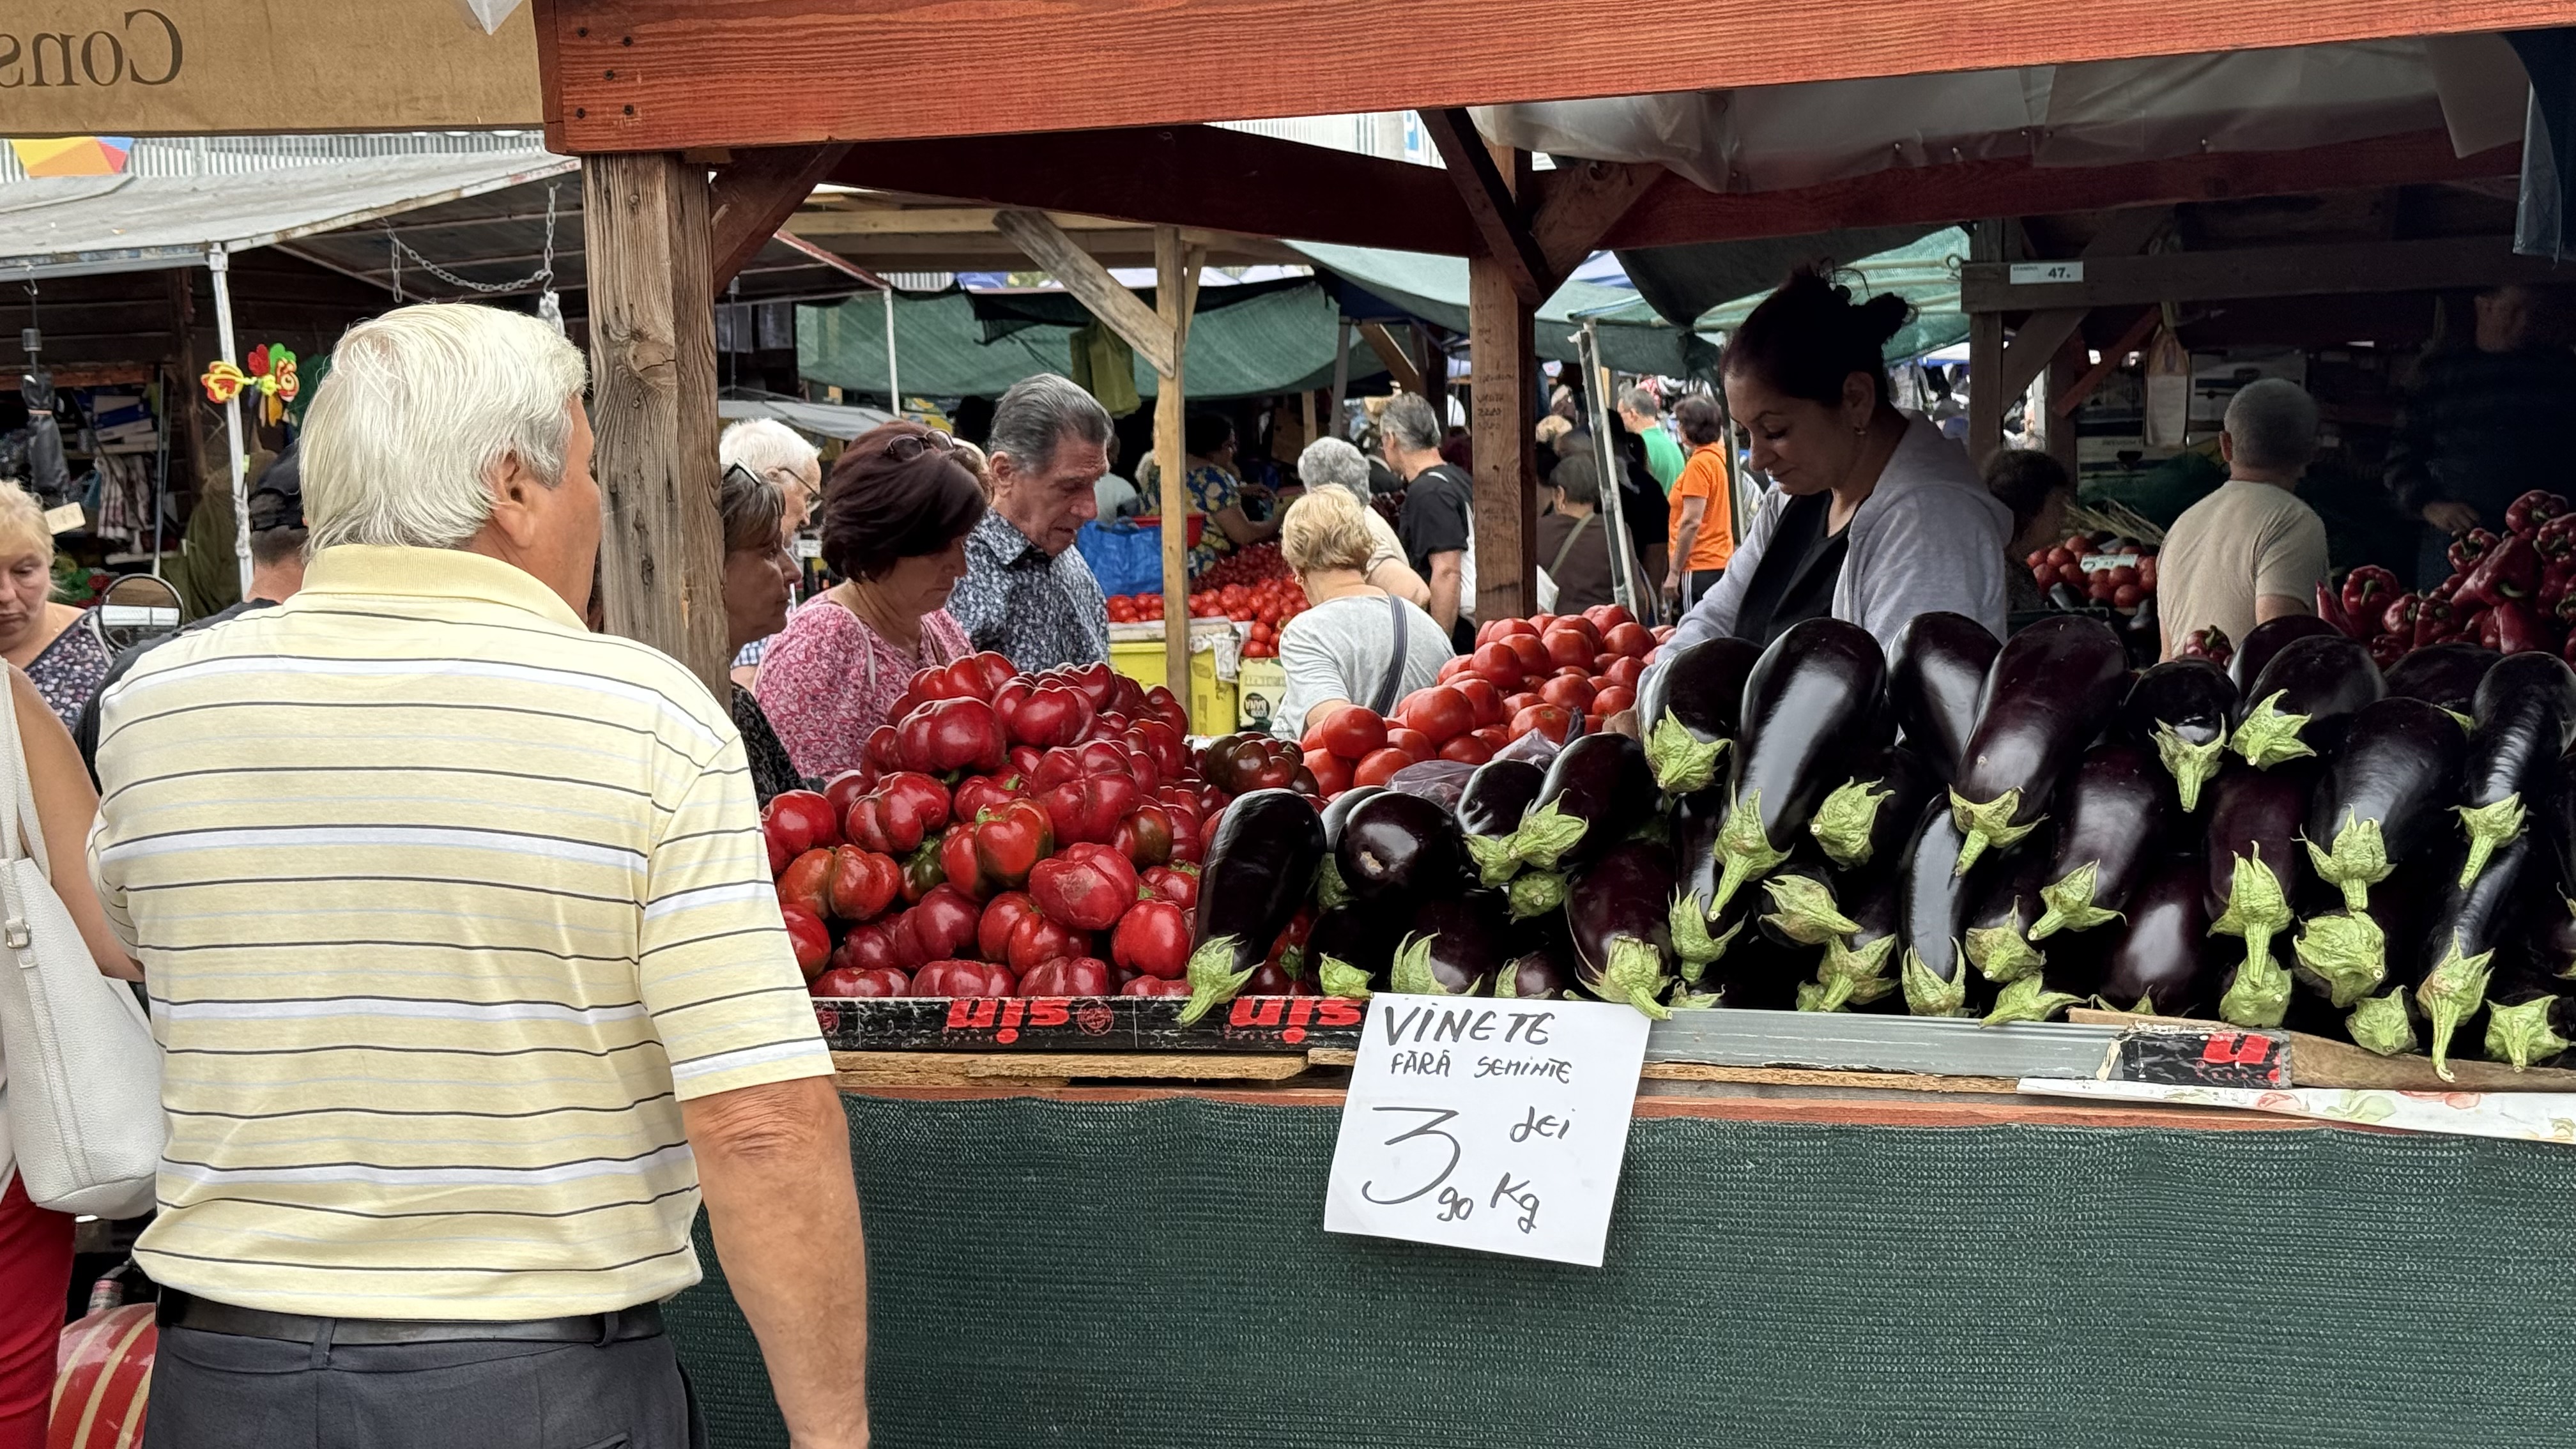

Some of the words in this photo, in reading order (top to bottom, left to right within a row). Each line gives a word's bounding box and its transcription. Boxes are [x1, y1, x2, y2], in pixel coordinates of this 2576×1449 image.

[2048, 266, 2071, 279] 47.
[1361, 1107, 1461, 1204] 3
[1437, 1186, 1473, 1222] 90
[1490, 1172, 1540, 1234] Kg
